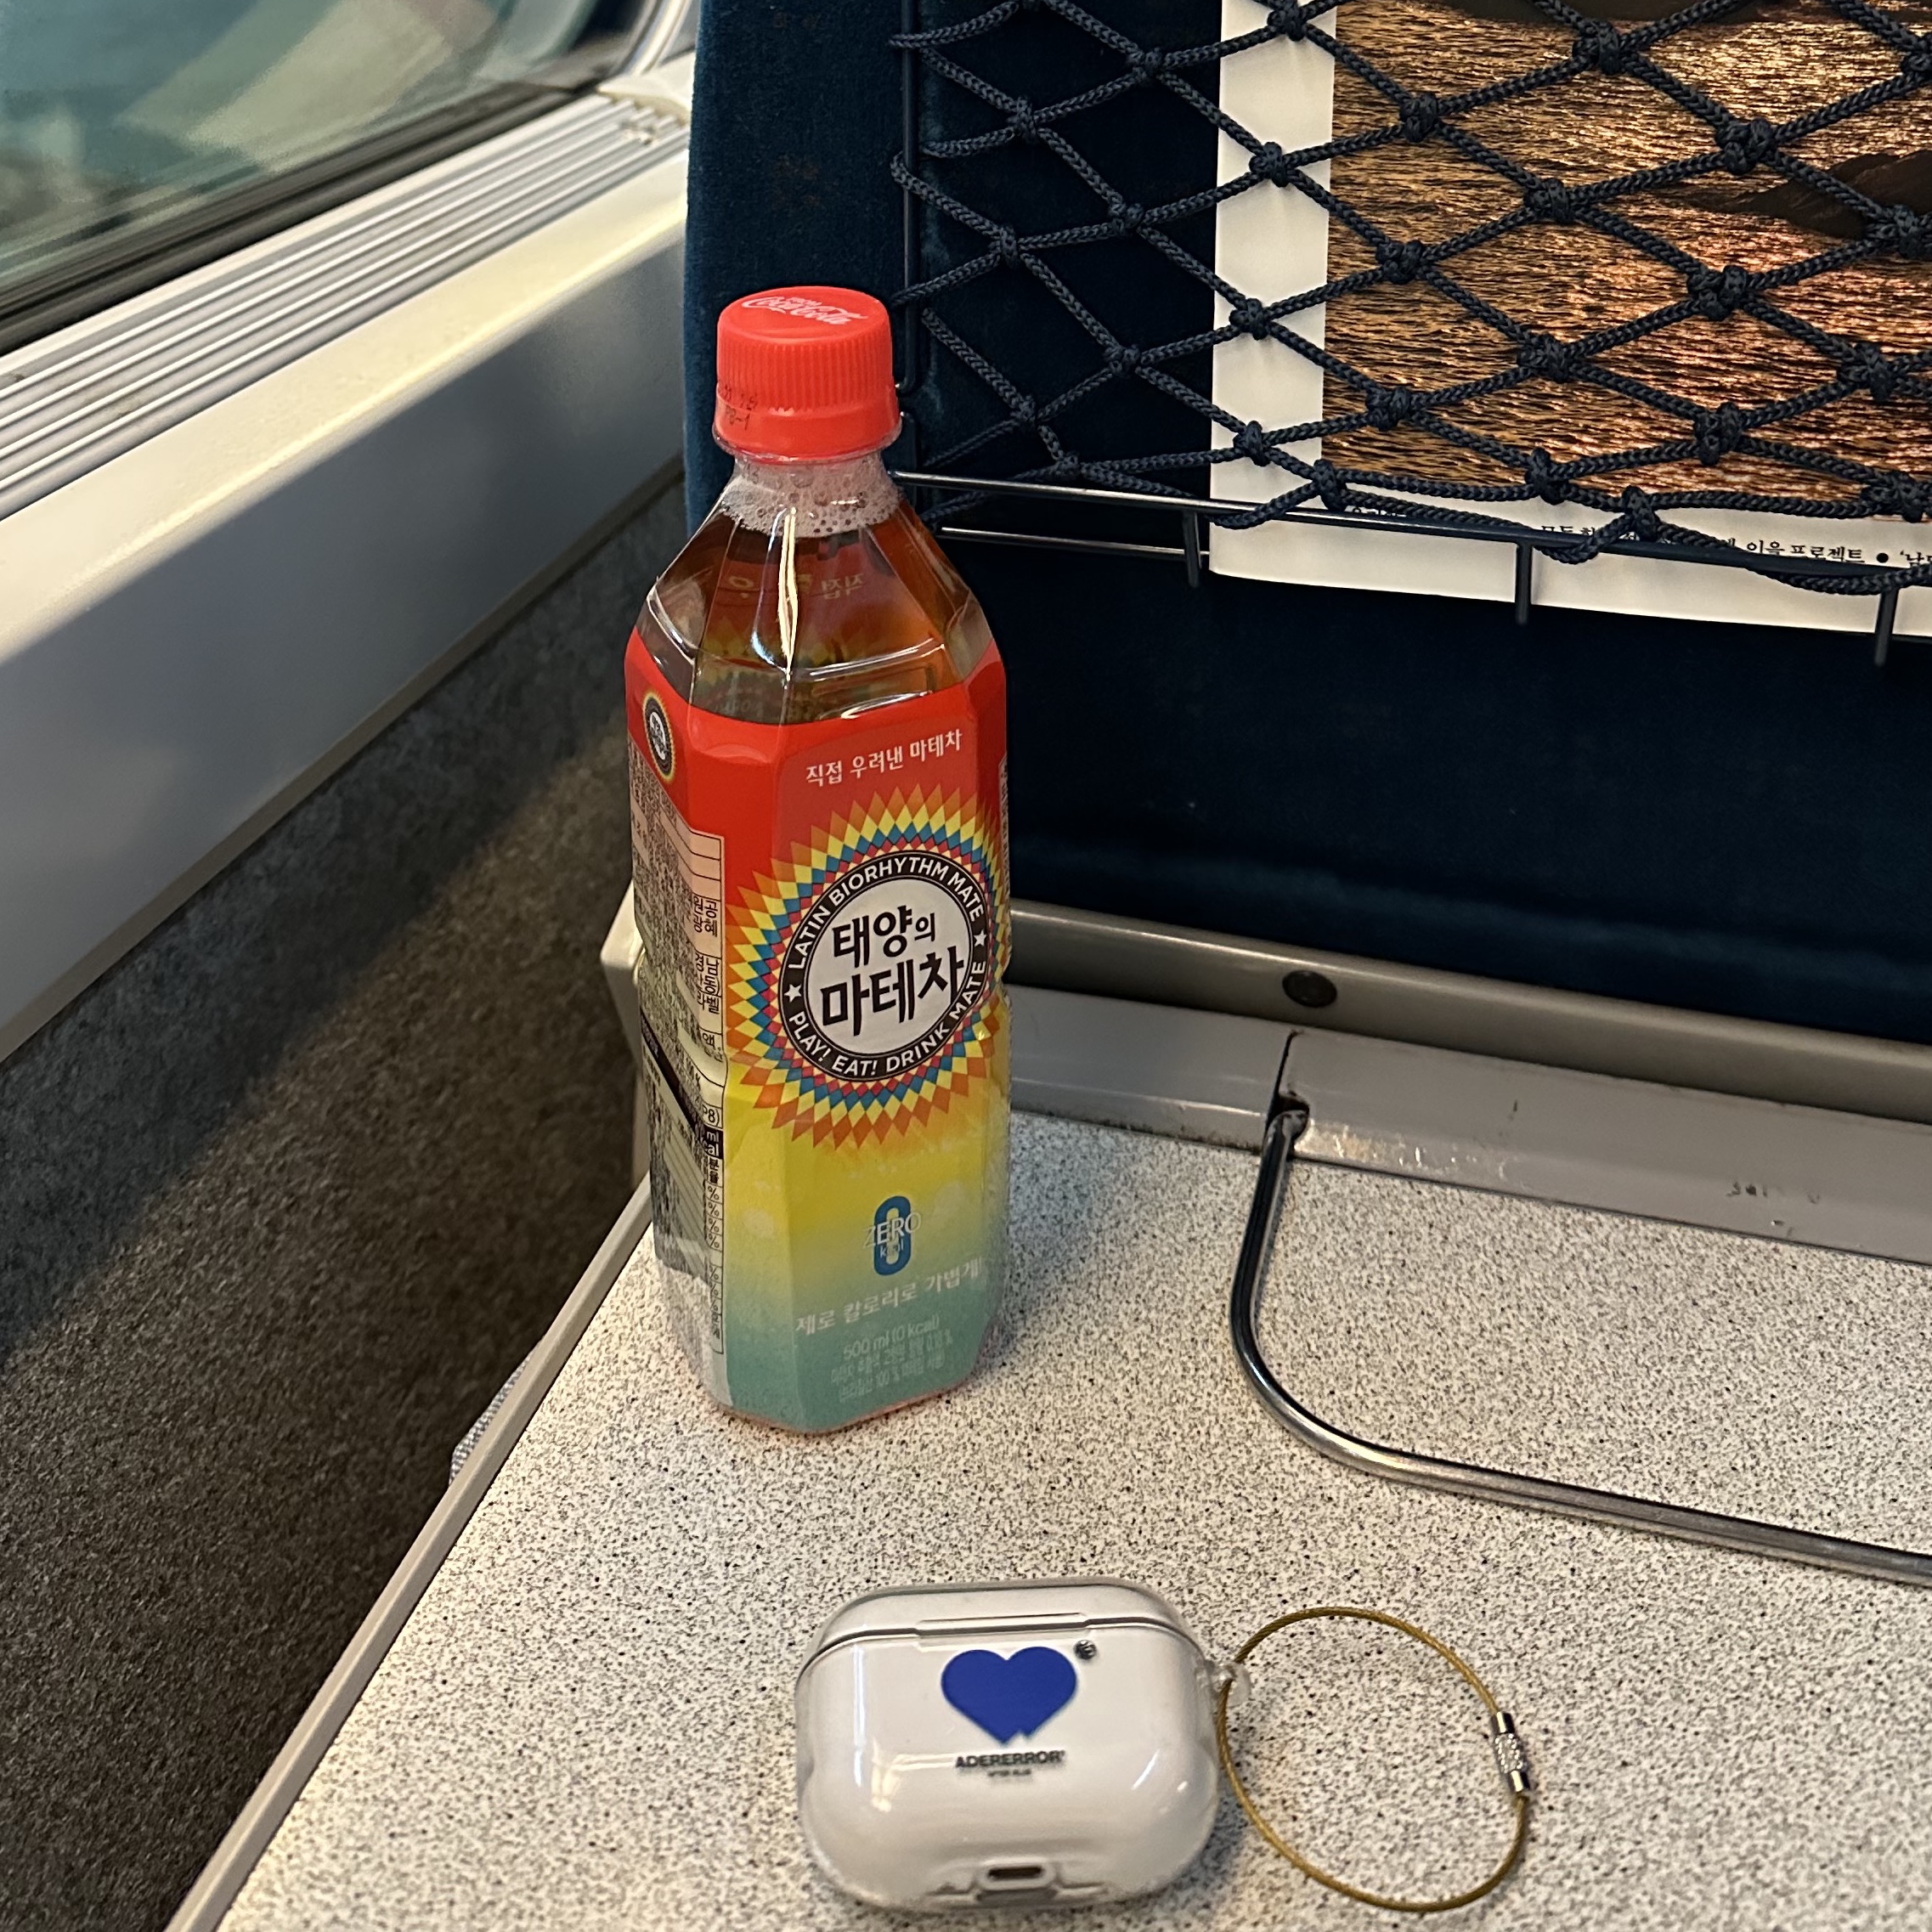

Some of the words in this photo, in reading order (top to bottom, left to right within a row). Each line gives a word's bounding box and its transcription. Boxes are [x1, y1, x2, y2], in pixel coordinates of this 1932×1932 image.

[1790, 545, 1865, 562] 프로젝트
[806, 760, 843, 787] 직접
[850, 746, 903, 778] 우려낸
[910, 729, 963, 763] 마테차
[788, 906, 831, 969] LATIN
[828, 856, 950, 906] BIORHYTHM
[946, 872, 985, 923] MATE
[832, 905, 935, 969] 태양의
[788, 1012, 831, 1062] PLAY!
[832, 1054, 877, 1076] EAT!
[885, 1025, 950, 1072] DRINK
[948, 960, 986, 1021] MATE
[820, 946, 964, 1037] 마테차
[862, 1212, 922, 1249] ZERO
[795, 1309, 835, 1336] 제로
[844, 1282, 918, 1325] 칼로리로
[926, 1256, 982, 1292] 가볍게
[955, 1749, 1065, 1768] ADERERROR
